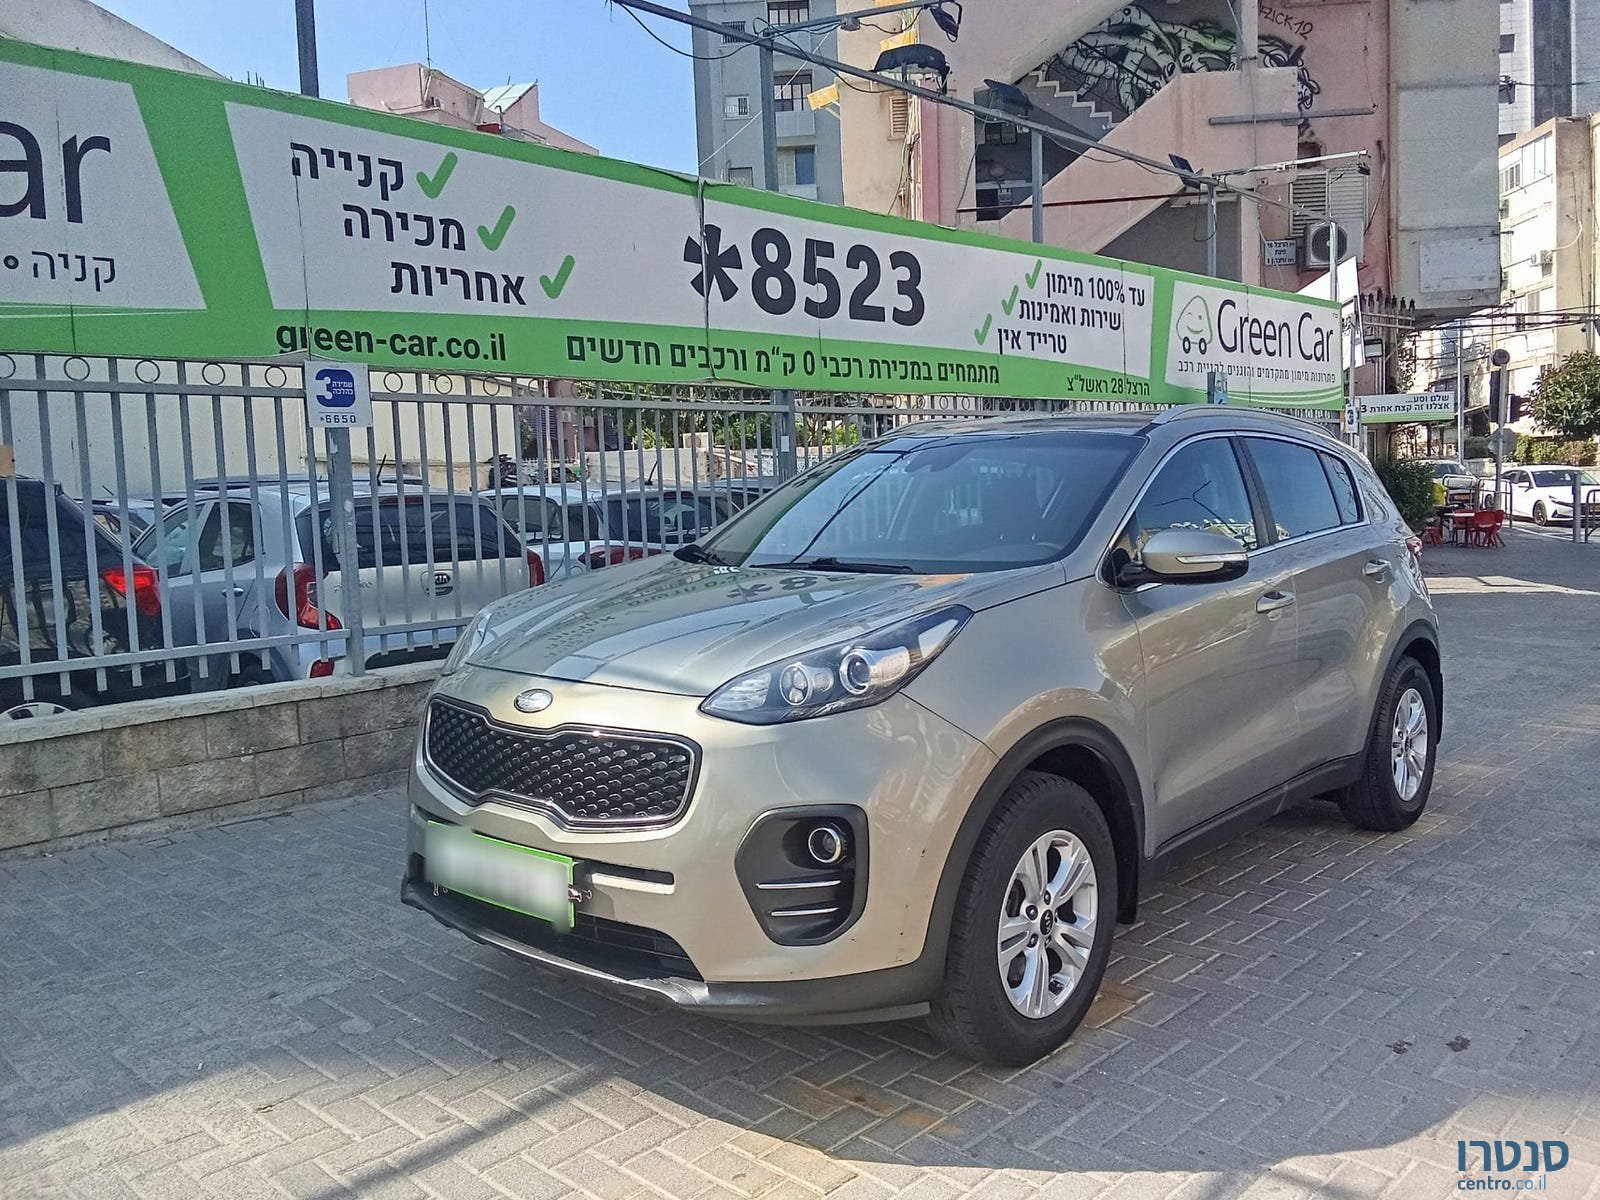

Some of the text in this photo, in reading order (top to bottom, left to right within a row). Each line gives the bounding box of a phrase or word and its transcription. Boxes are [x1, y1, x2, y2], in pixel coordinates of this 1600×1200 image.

[289, 142, 404, 201] קנייה
[342, 203, 466, 251] מכירה
[32, 250, 116, 293] קניה
[391, 261, 527, 306] אחריות
[1046, 271, 1146, 307] עד 100% מימון
[1019, 299, 1121, 331] שירות ואמינות
[275, 324, 507, 362] green-car.co.il
[997, 327, 1068, 355] טרייד אין
[1217, 298, 1334, 362] Green Car
[566, 335, 661, 367] חדשים
[670, 343, 748, 372] ורכבים
[803, 349, 816, 376] 0
[821, 355, 865, 379] רכבי
[868, 358, 933, 382] במכירת
[938, 362, 1000, 385] מתמחים
[1178, 360, 1194, 373] רכב
[1110, 377, 1124, 394] 28
[1126, 378, 1150, 396] הרצל
[1430, 394, 1449, 402] שלם
[1369, 405, 1393, 413] אחרת
[1394, 404, 1412, 413] קצת
[1414, 403, 1424, 411] זה
[1425, 402, 1450, 411] אצלנו
